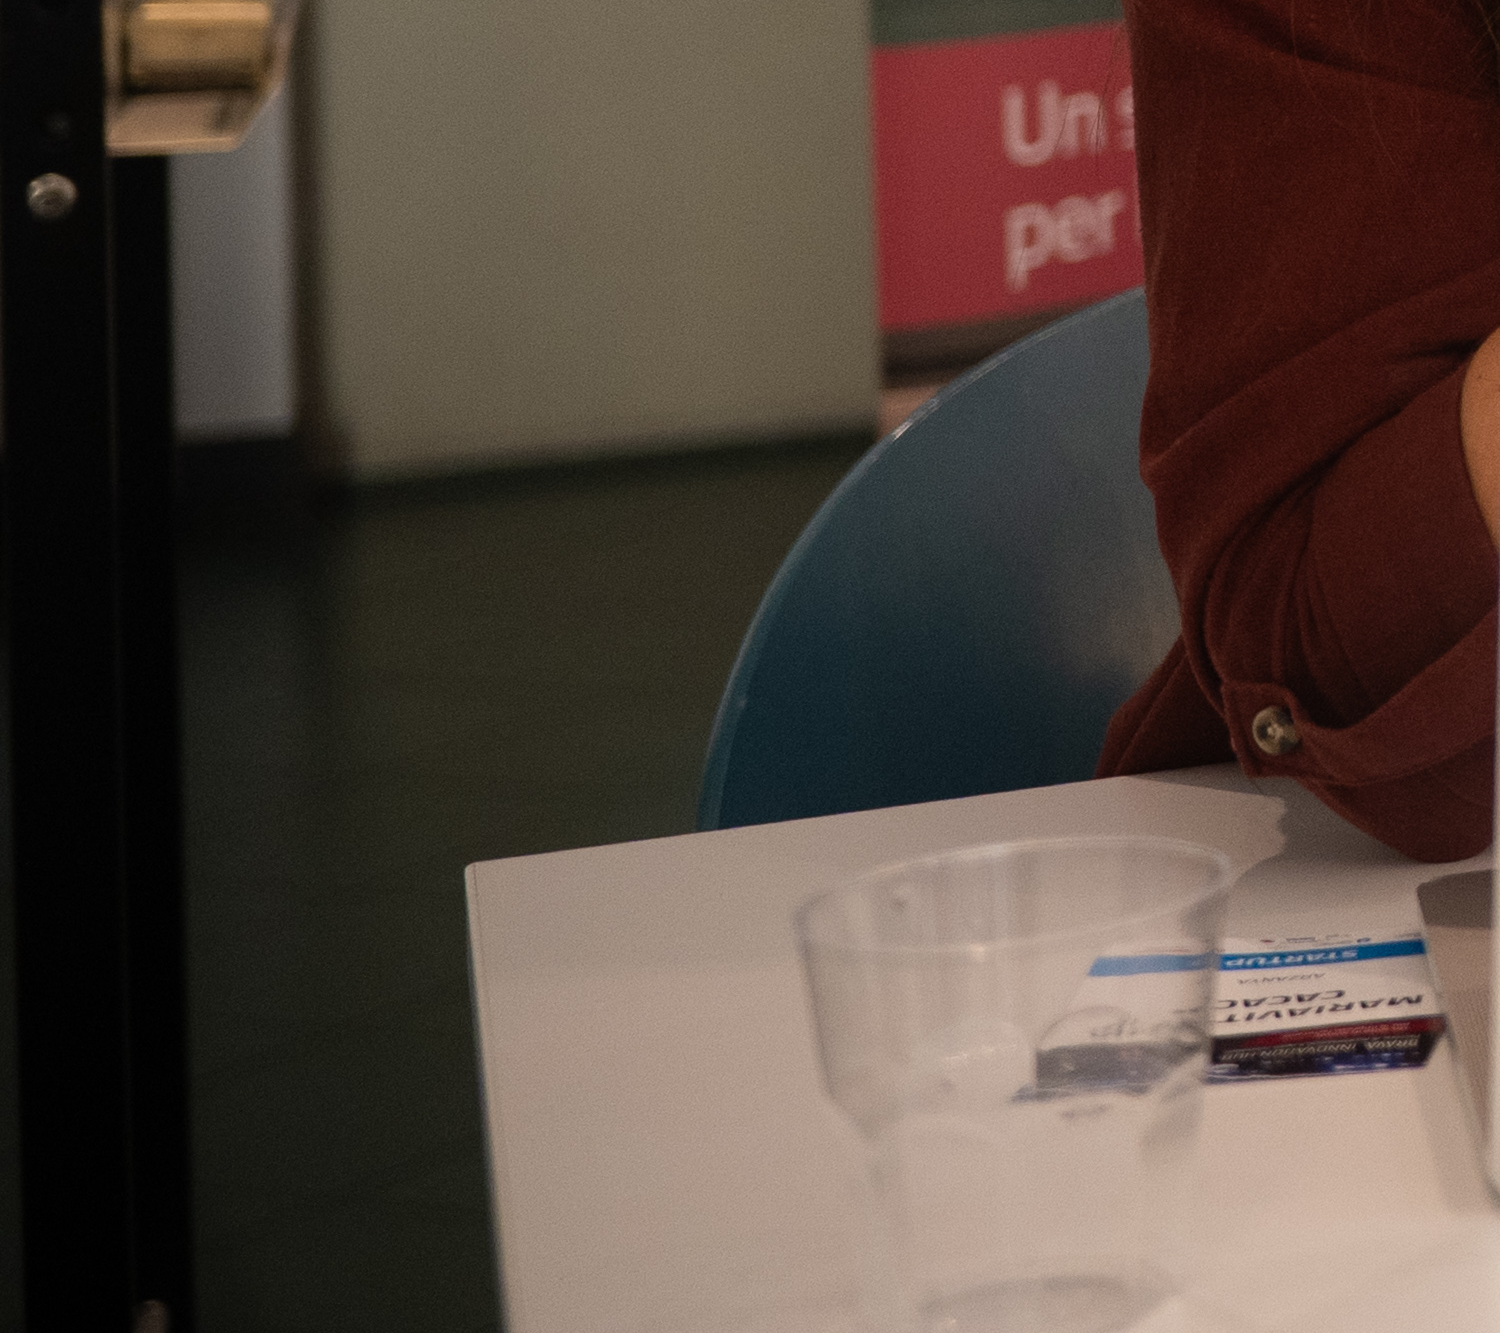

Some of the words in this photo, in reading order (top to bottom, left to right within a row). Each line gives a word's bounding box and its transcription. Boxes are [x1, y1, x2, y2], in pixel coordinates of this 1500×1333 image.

[1001, 78, 1105, 168] Un
[1002, 187, 1130, 294] per
[1225, 948, 1359, 968] STARTUP
[1210, 993, 1424, 1024] MARIAVIT
[1216, 988, 1346, 1010] CACAC
